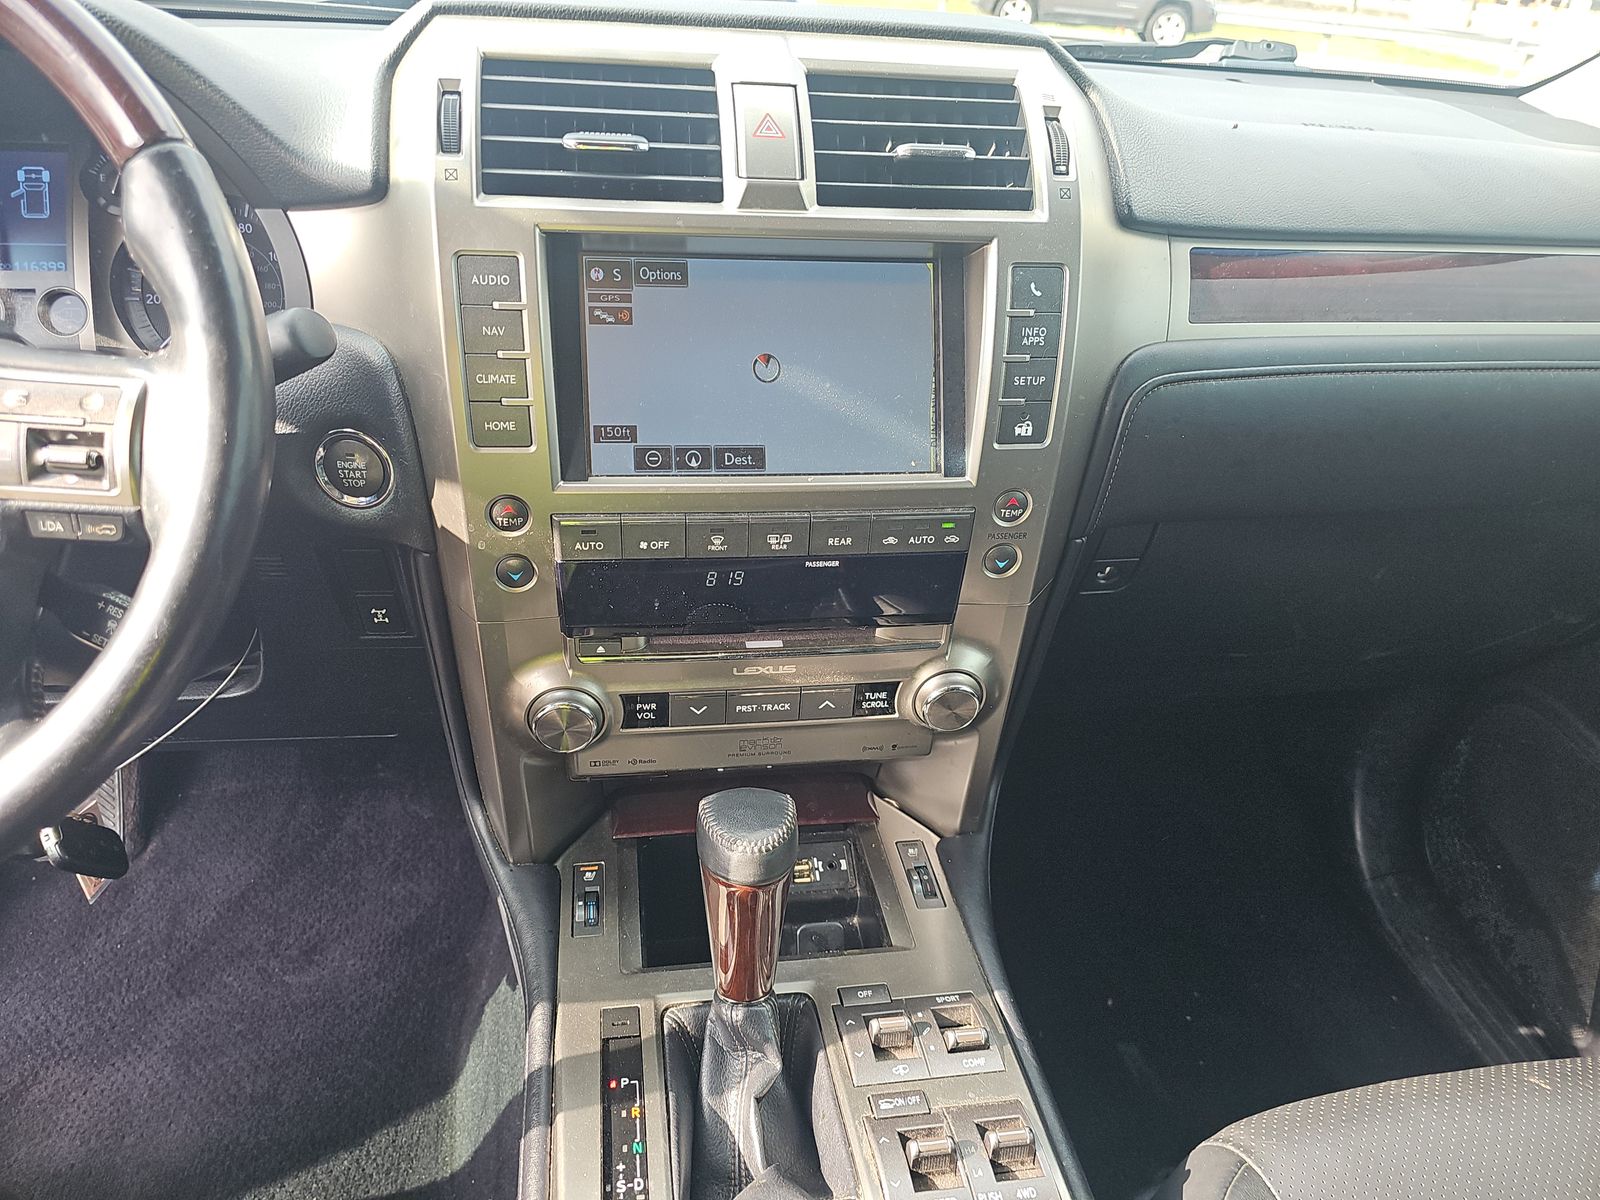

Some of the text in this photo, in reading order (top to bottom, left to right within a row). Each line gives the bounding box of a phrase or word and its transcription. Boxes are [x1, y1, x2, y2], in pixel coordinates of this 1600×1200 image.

[14, 260, 66, 272] 116399
[471, 274, 511, 286] AUDIO
[612, 266, 683, 284] S Options
[600, 294, 621, 302] GPS
[482, 325, 505, 337] NAV
[1021, 327, 1047, 337] INFO
[1021, 337, 1045, 346] APPS
[475, 374, 517, 385] CLIMATE
[1013, 375, 1046, 386] SETUP
[484, 420, 517, 431] HOME
[600, 426, 631, 438] 150ft
[724, 452, 756, 466] Dest.
[336, 460, 367, 470] ENGINE
[338, 469, 367, 479] START
[342, 478, 366, 488] STOP
[1000, 508, 1023, 519] TEMP
[40, 520, 65, 534] LDA
[496, 516, 524, 528] TEMP
[908, 535, 936, 545] AUTO
[987, 531, 1027, 541] PASSENGER
[574, 541, 604, 551] AUTO
[650, 540, 670, 550] OFF
[771, 543, 788, 551] REAR
[827, 537, 852, 547] REAR
[707, 544, 728, 552] FRONT
[805, 560, 840, 568] PASSENGER
[106, 604, 124, 619] RES
[732, 664, 797, 676] LEXUS
[864, 691, 888, 700] TUNE
[636, 703, 657, 711] PWR
[861, 700, 889, 709] SCROLL
[636, 712, 656, 720] VOL
[857, 989, 873, 998] OFF
[935, 994, 961, 1003] SPORT
[620, 1077, 629, 1089] P
[631, 1106, 641, 1119] R
[632, 1141, 644, 1154] N
[977, 1190, 1003, 1200] PUSH
[1016, 1187, 1037, 1199] 4WD
